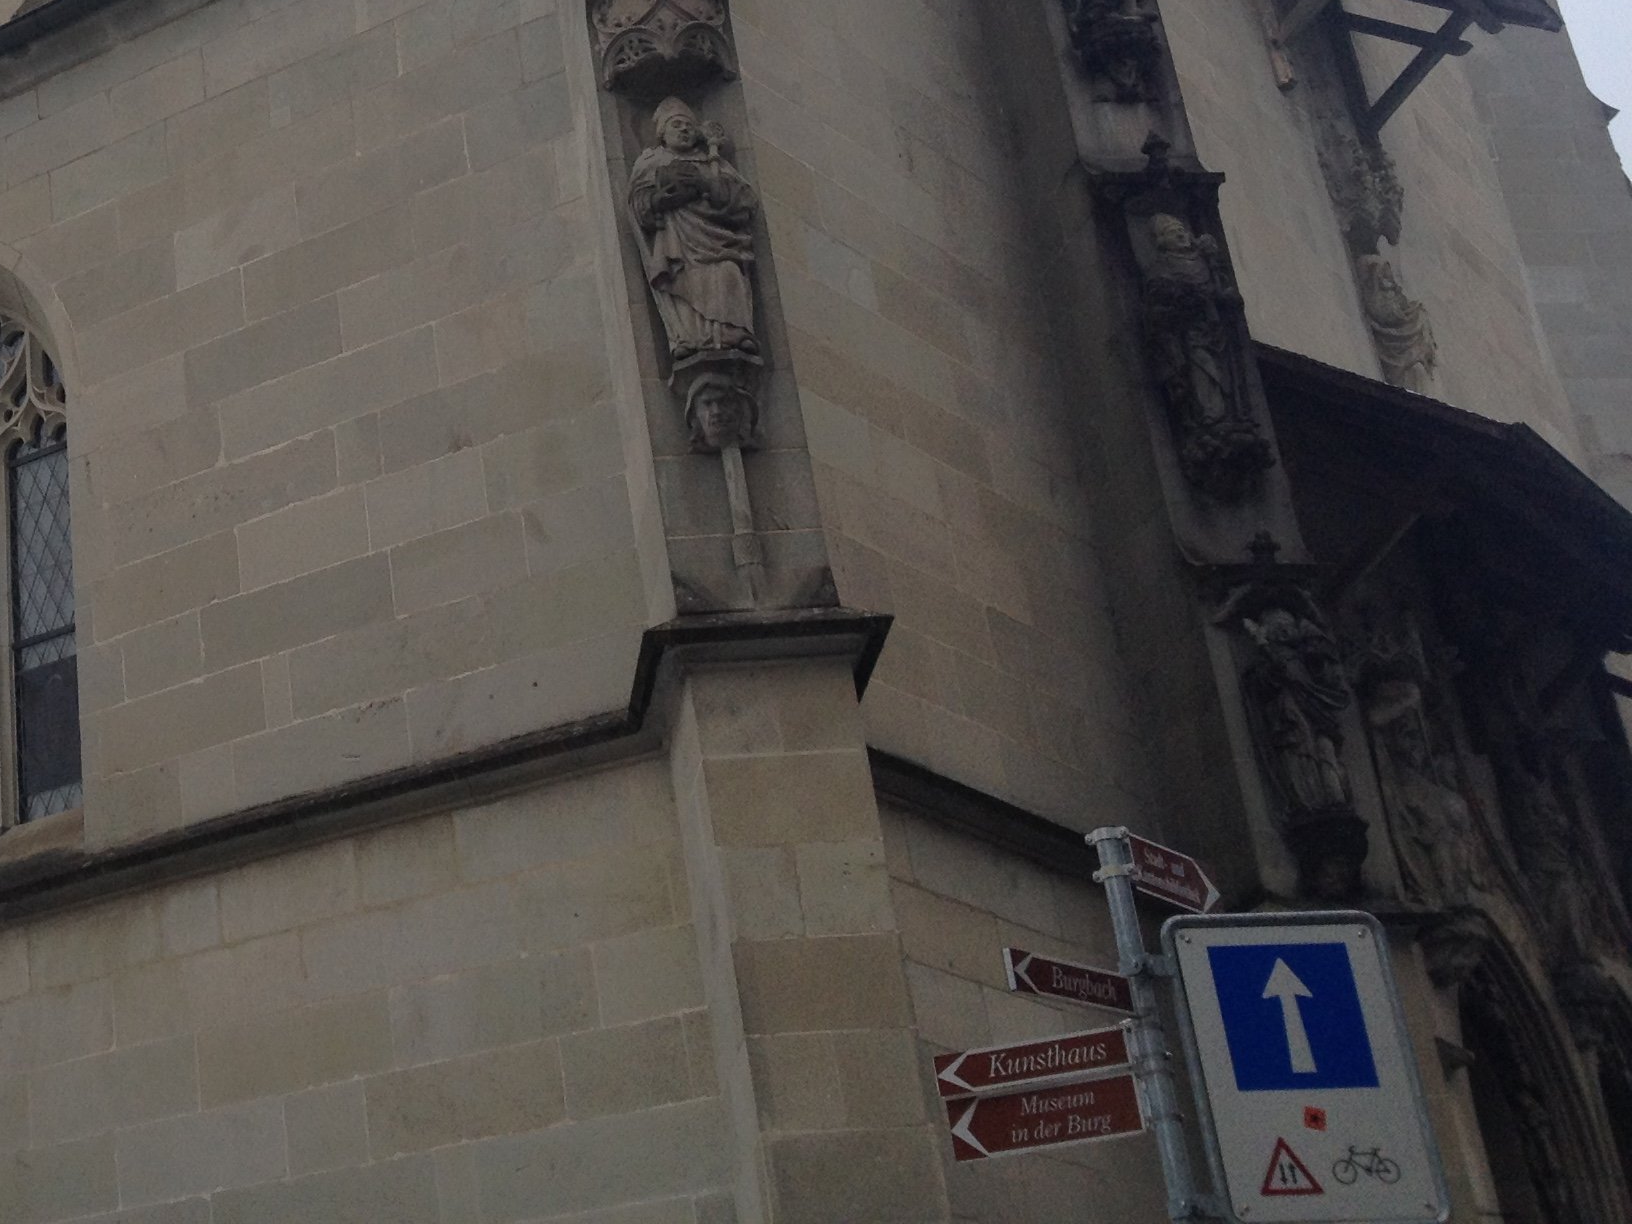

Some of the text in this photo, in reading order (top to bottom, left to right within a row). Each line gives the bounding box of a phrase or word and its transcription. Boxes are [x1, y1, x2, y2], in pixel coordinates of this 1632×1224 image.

[1052, 966, 1117, 1001] Burgbach
[988, 1042, 1108, 1078] Kunsthaus
[1020, 1091, 1095, 1116] Museum
[1011, 1113, 1112, 1143] in der Burg
